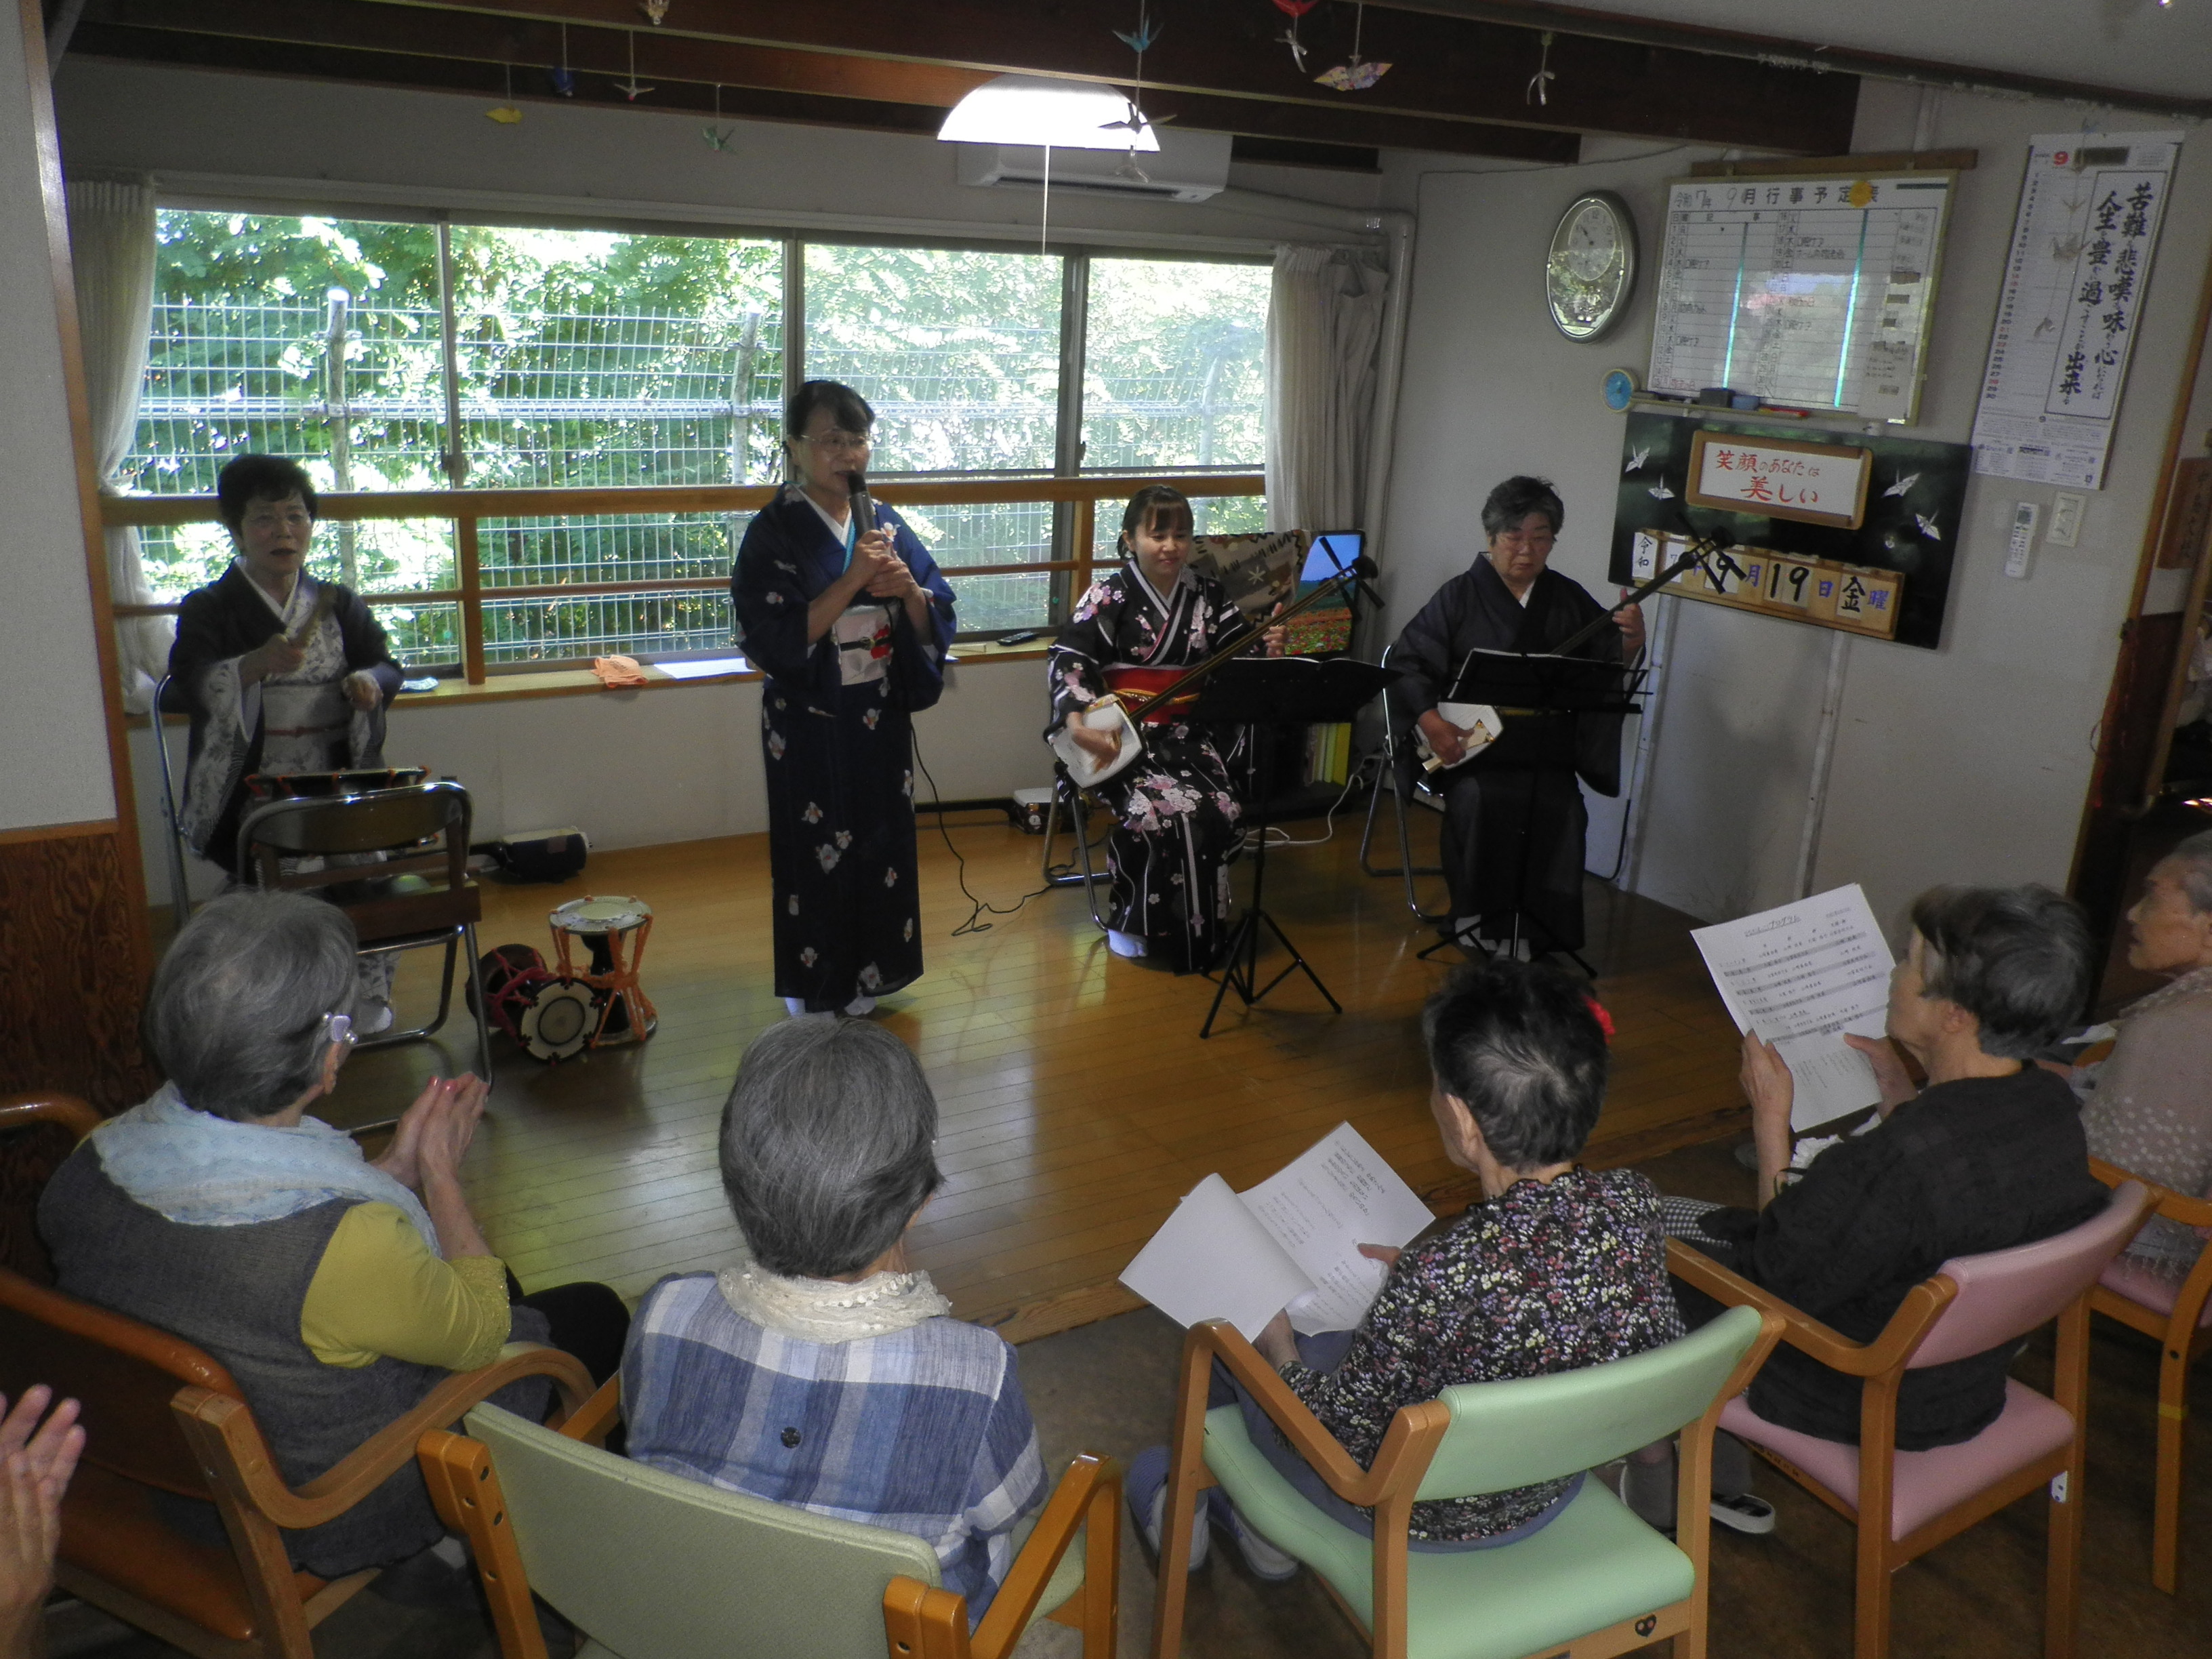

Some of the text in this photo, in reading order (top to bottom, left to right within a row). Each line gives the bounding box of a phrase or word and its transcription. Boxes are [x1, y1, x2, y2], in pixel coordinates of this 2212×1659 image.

[2053, 151, 2069, 165] 9
[1716, 449, 1820, 477] 笑顔のあなたは
[1740, 476, 1818, 504] 美しい
